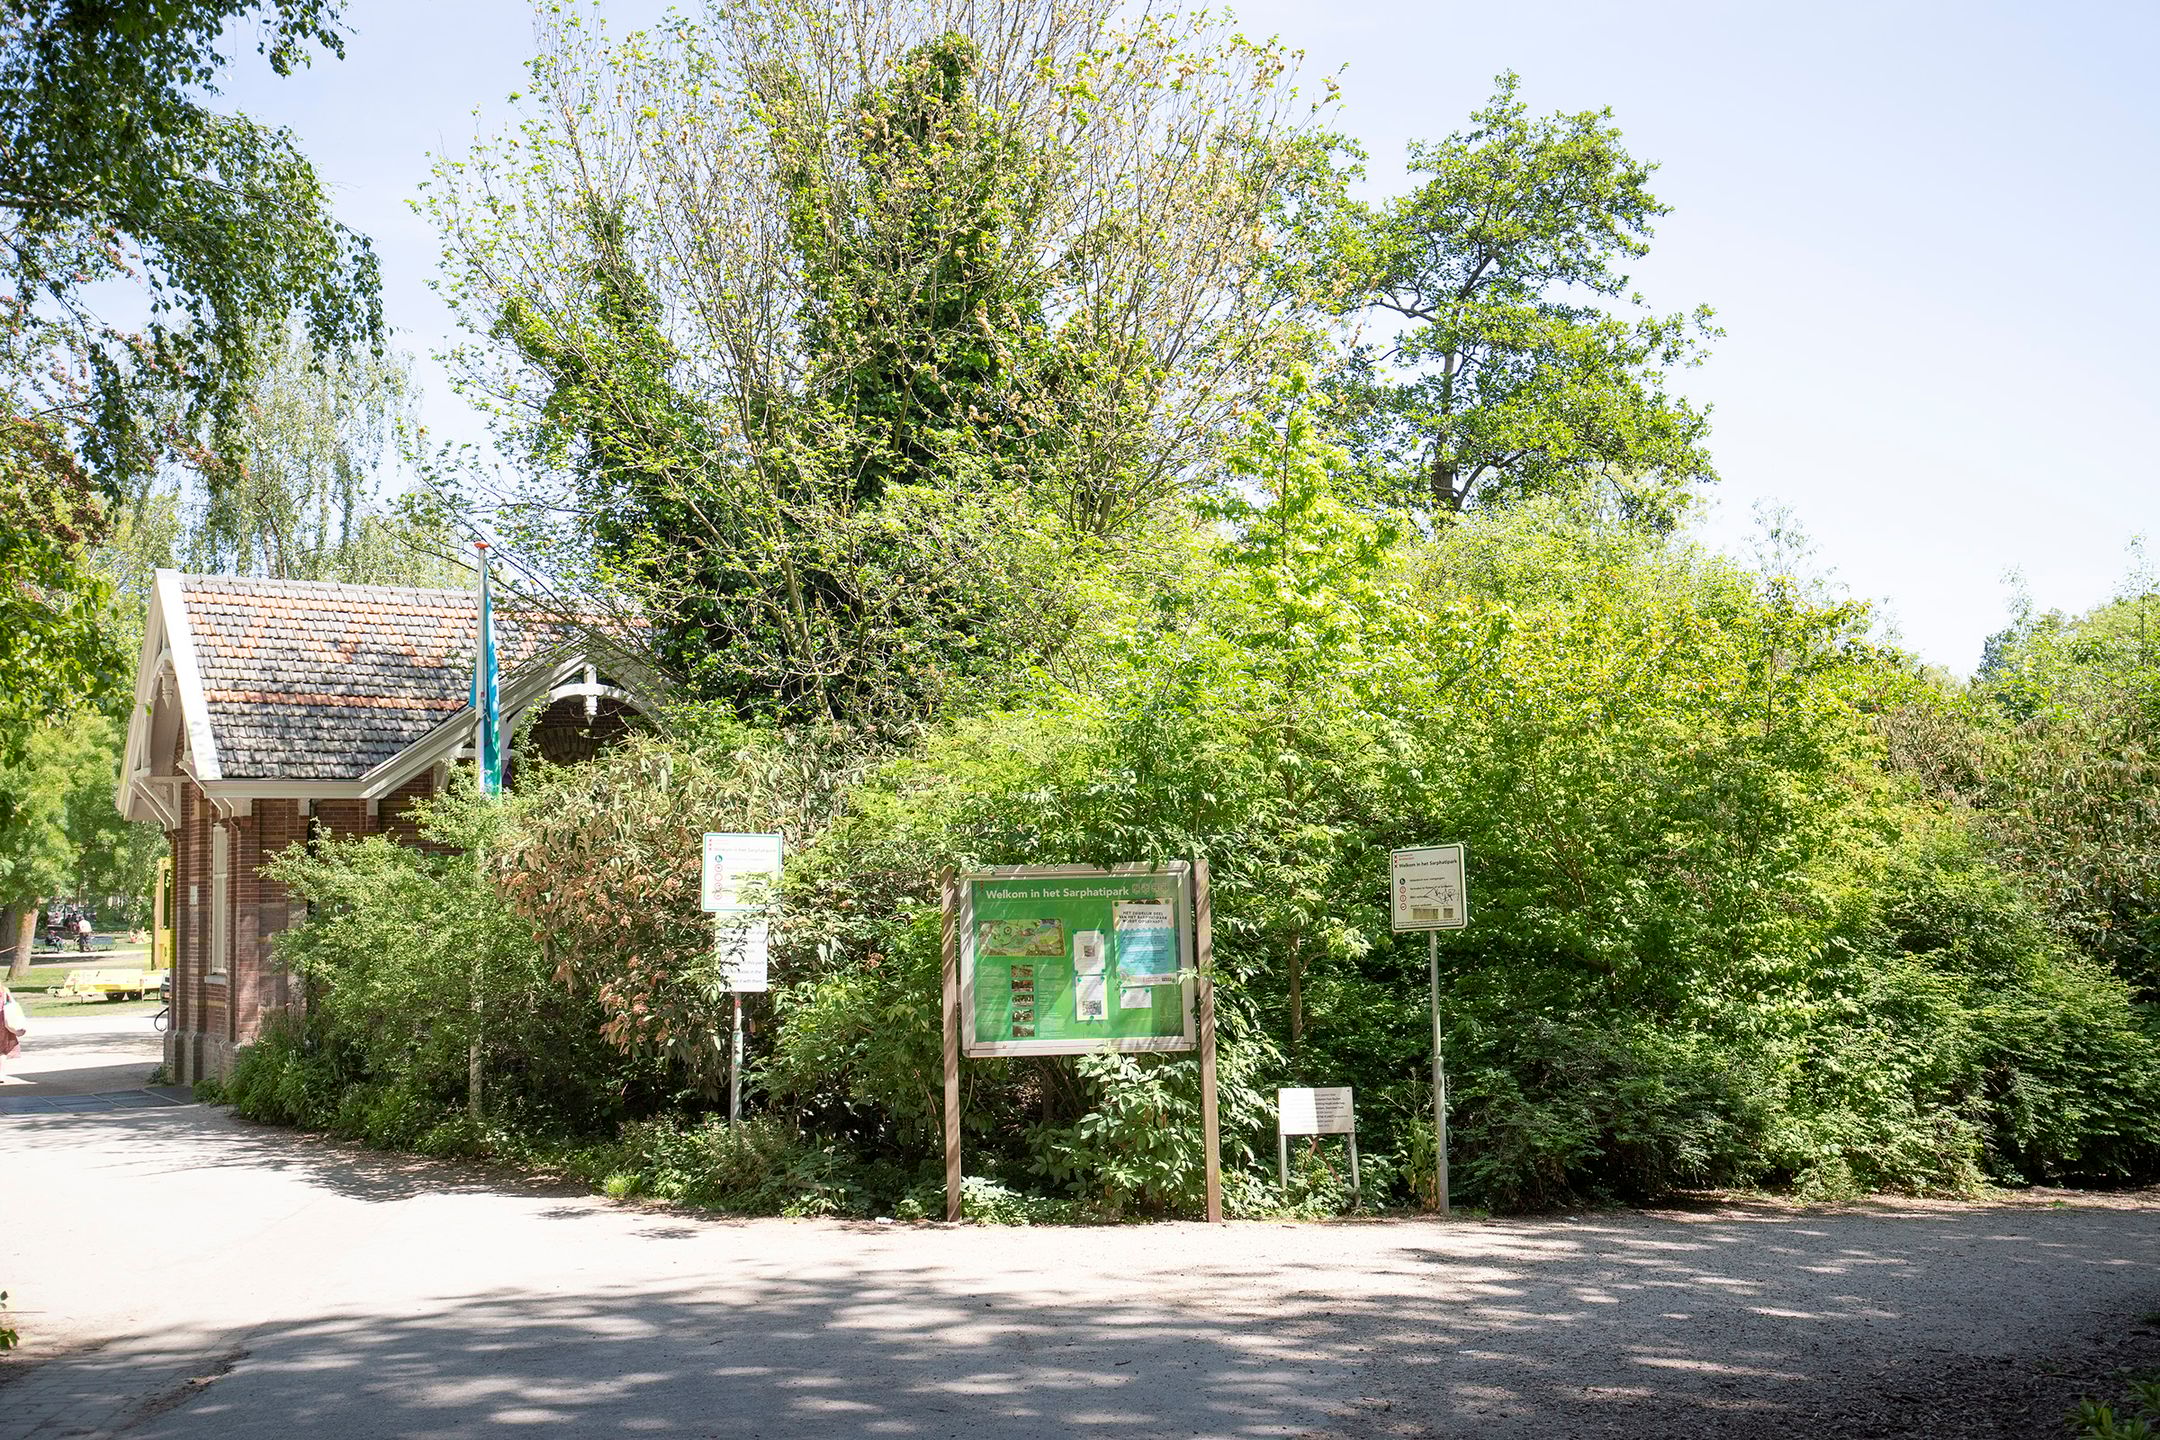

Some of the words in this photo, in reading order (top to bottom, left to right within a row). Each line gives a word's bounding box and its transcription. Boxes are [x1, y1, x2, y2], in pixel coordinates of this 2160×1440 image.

[986, 890, 1028, 899] Welkom
[1030, 889, 1040, 898] in
[1043, 888, 1060, 898] het
[1063, 886, 1129, 899] Sarphatipark
